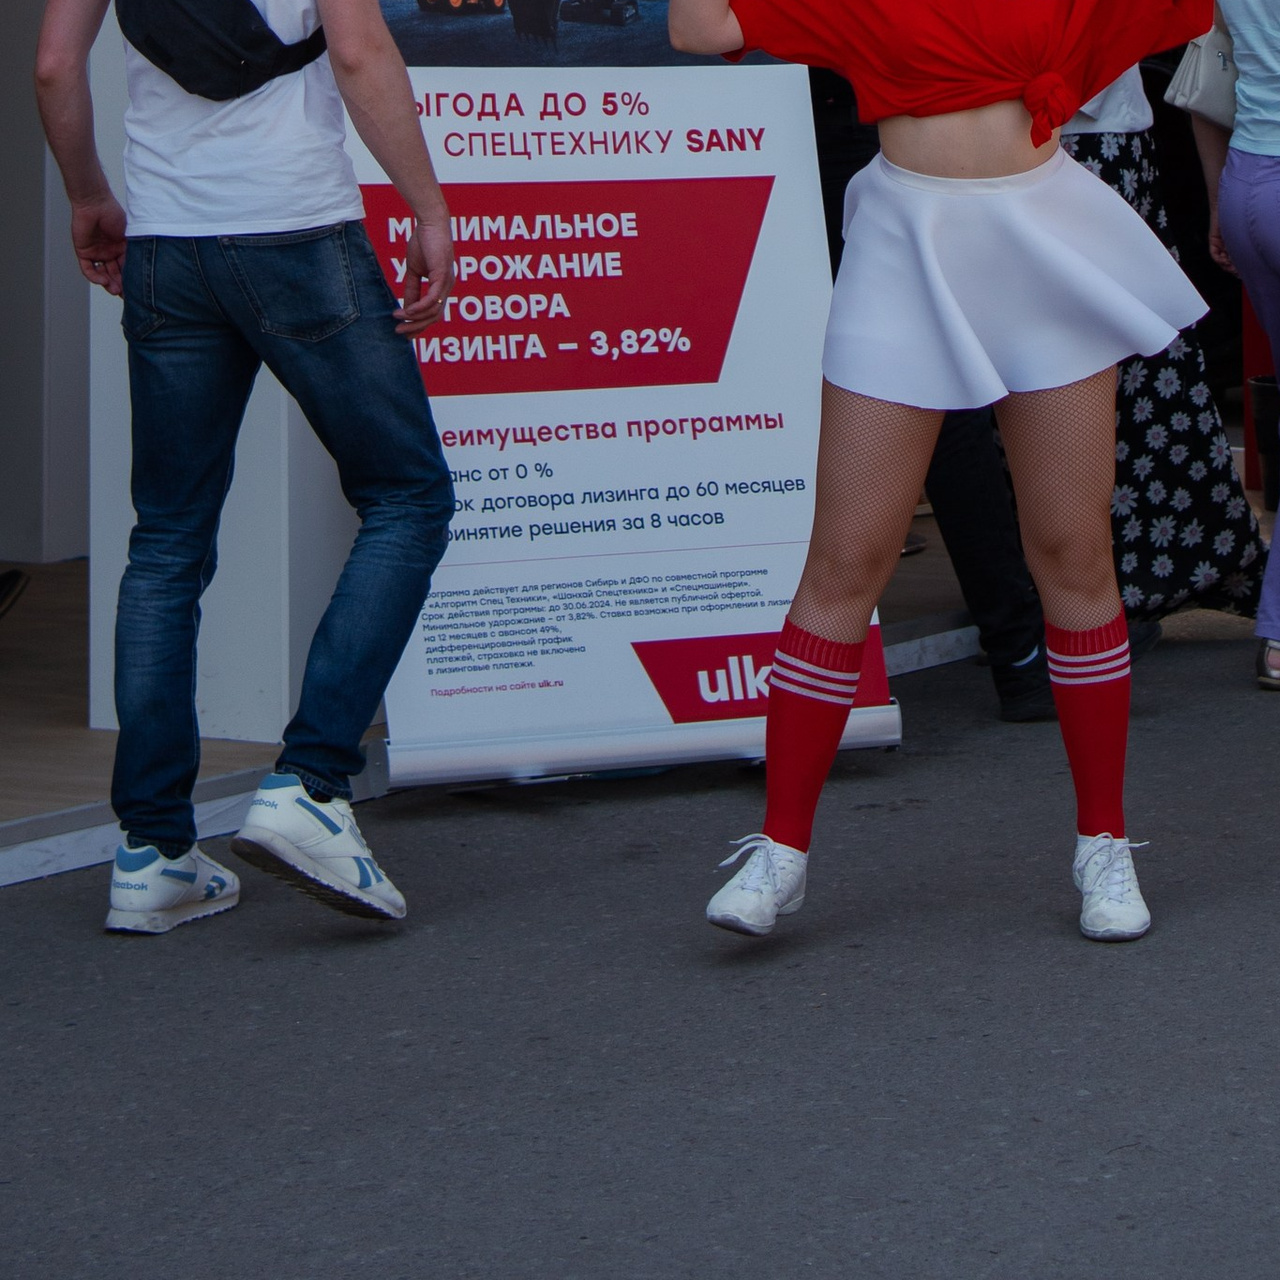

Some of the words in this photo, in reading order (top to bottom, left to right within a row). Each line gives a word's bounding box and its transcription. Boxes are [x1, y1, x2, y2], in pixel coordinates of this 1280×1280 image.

[413, 92, 525, 121] ЫГОДА
[540, 92, 587, 121] ДО
[601, 92, 650, 117] 5%
[444, 129, 673, 160] СПЕЦТЕХНИКУ
[686, 127, 766, 153] SANY
[388, 212, 638, 243] МИМАЛЬНОЕ
[391, 252, 622, 283] УРОЖАНИЕ
[398, 293, 570, 322] ГОВОРА
[591, 327, 691, 361] 3,82%
[441, 420, 617, 451] еимущества
[627, 410, 785, 443] программы
[450, 468, 482, 483] анс
[488, 467, 509, 481] от
[516, 463, 528, 479] 0
[535, 462, 554, 478] %
[454, 498, 475, 512] ок
[481, 492, 575, 513] договора
[581, 486, 660, 505] лизинга
[665, 484, 691, 502] до
[696, 481, 719, 498] 60
[725, 476, 806, 497] месяцев
[448, 524, 523, 542] инятие
[529, 518, 616, 541] решения
[622, 516, 645, 532] за
[651, 512, 662, 529] 8
[667, 508, 724, 528] часов
[427, 588, 470, 599] ограмма
[473, 585, 519, 596] действует
[522, 584, 539, 593] для
[541, 581, 583, 592] регионов
[585, 578, 619, 588] Сибирь
[629, 576, 650, 585] ДФО
[665, 571, 718, 582] совместной
[720, 568, 768, 579] программе
[429, 600, 478, 609] «Алгоритм
[480, 597, 504, 607] Спец
[552, 589, 593, 600] «Шанхай
[596, 587, 658, 597] Спецтехника»
[422, 612, 444, 621] Срок
[447, 608, 490, 620] действия
[492, 606, 546, 617] программы:
[615, 599, 627, 607] Не
[629, 596, 669, 605] является
[671, 592, 719, 604] публичной
[721, 589, 763, 600] офертой.
[423, 621, 486, 631] Минимальное
[488, 616, 546, 628] удорожание
[600, 610, 632, 618] Ставка
[634, 607, 679, 616] возможна
[681, 606, 698, 615] при
[700, 601, 758, 612] оформлении
[767, 599, 793, 607] лизин
[425, 637, 536, 654] дифференцированный
[538, 635, 573, 646] график
[449, 631, 488, 640] месяцев
[498, 628, 538, 637] авансом
[426, 653, 475, 664] платежей,
[477, 650, 525, 661] страховка
[540, 646, 586, 655] включена
[436, 664, 490, 674] лизинговые
[492, 661, 535, 670] платежи.
[430, 685, 493, 697] Подробности
[509, 681, 536, 690] сайте
[538, 680, 564, 688] ulk.ru
